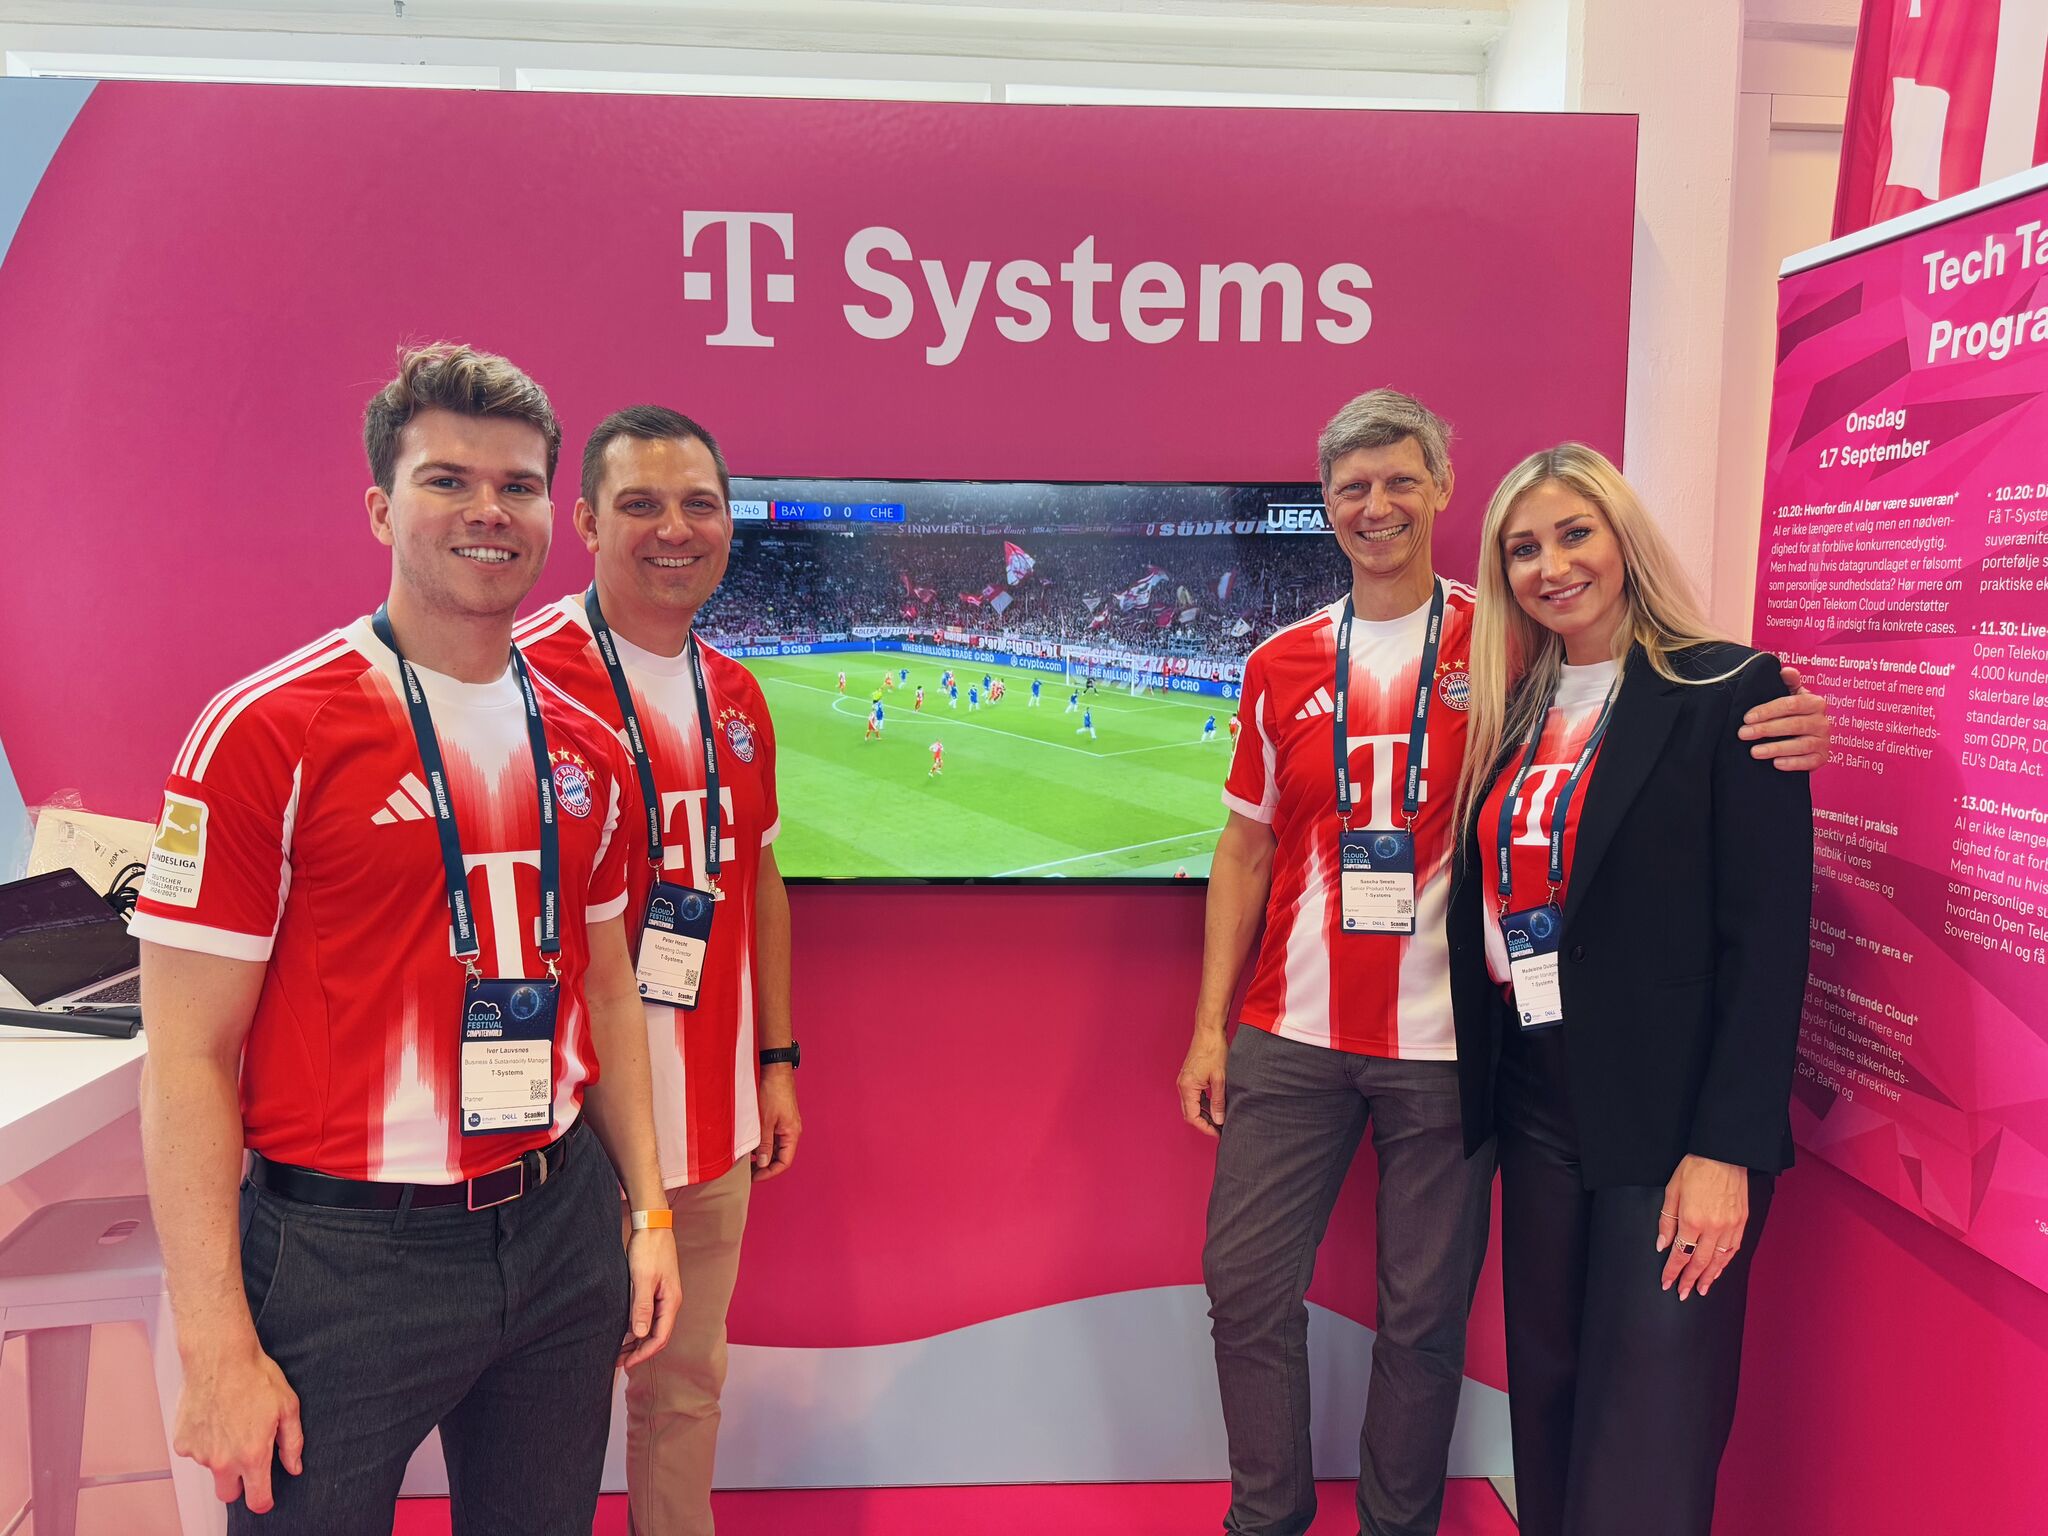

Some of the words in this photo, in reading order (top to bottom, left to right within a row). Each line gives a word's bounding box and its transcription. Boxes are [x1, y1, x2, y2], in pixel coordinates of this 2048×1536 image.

[1923, 236, 2006, 294] Tech
[682, 210, 795, 348] T
[842, 225, 1373, 366] Systems
[1846, 407, 1907, 433] Onsdag
[1819, 448, 1838, 469] 17
[1841, 438, 1930, 468] September
[1995, 485, 2034, 501] 10.20:
[781, 506, 805, 516] BAY
[823, 507, 831, 518] 0
[843, 507, 851, 518] 0
[870, 507, 894, 518] CHE
[1778, 506, 1802, 518] 10.20:
[1804, 503, 1836, 516] Hvorfor
[1838, 502, 1852, 514] din
[1853, 500, 1863, 512] AI
[1865, 499, 1881, 511] bør
[1883, 498, 1907, 510] være
[1988, 508, 2001, 524] Få
[1773, 525, 1781, 536] AI
[1782, 526, 1791, 535] er
[1792, 524, 1807, 535] ikke
[1808, 522, 1842, 534] længere
[1844, 522, 1853, 532] et
[1855, 520, 1874, 533] valg
[1876, 520, 1896, 531] men
[1898, 519, 1911, 529] en
[1912, 515, 1955, 528] nødven-
[1771, 543, 1797, 557] dighed
[1800, 542, 1811, 553] for
[1812, 542, 1820, 553] at
[1822, 539, 1853, 553] forblive
[1855, 537, 1946, 552] konkurrencedygtig.
[1770, 561, 1786, 572] Men
[1788, 560, 1807, 572] hvad
[1809, 562, 1818, 572] nu
[1820, 560, 1837, 571] hvis
[1839, 558, 1908, 574] datagrundlaget
[1910, 559, 1920, 570] er
[1922, 557, 1962, 570] følsomt
[1982, 554, 2039, 572] portefølje
[1769, 582, 1785, 591] som
[1786, 579, 1827, 593] personlige
[1829, 578, 1895, 591] sundhedsdata?
[1898, 579, 1915, 591] Hør
[1917, 579, 1944, 591] mere
[1945, 580, 1962, 591] om
[1980, 577, 2033, 594] praktiske
[1768, 597, 1798, 609] hvordan
[1800, 597, 1821, 612] Open
[1822, 597, 1857, 610] Telekom
[1859, 598, 1885, 611] Cloud
[1888, 600, 1949, 612] understøtter
[1766, 615, 1803, 629] Sovereign
[1804, 616, 1812, 628] AI
[1814, 619, 1825, 630] og
[1827, 615, 1835, 629] få
[1837, 617, 1866, 632] indsigt
[1868, 619, 1880, 631] fra
[1882, 619, 1923, 633] konkrete
[1925, 622, 1957, 634] cases.
[1980, 622, 2018, 636] 11.30:
[745, 646, 778, 656] TRADE
[792, 645, 811, 654] CRO
[951, 649, 973, 660] TRADE
[980, 653, 994, 663] CRO
[1973, 643, 2004, 660] Open
[1019, 658, 1062, 672] crypto.com
[1791, 653, 1838, 668] Live-demo:
[1839, 656, 1878, 672] Europa's
[1880, 658, 1917, 674] førende
[1817, 673, 1840, 687] Cloud
[1843, 676, 1851, 688] er
[1853, 676, 1885, 691] betroet
[1971, 665, 2005, 681] 4.000
[1181, 680, 1200, 691] CRO
[1441, 678, 1449, 688] FC
[1968, 688, 2029, 705] skalerbare
[1966, 710, 2030, 728] standarder
[1964, 733, 1988, 745] som
[1991, 734, 2029, 754] GDPR,
[1962, 751, 1986, 768] EU's
[1989, 755, 2017, 773] Data
[2019, 760, 2044, 777] Act.
[556, 774, 562, 786] FC
[1345, 732, 1430, 831] T
[431, 770, 451, 820] COMPUTERWORLD
[541, 777, 553, 824] COMPUTERWORLD
[1512, 762, 1577, 846] T
[1961, 795, 1998, 814] 13.00:
[1865, 818, 1898, 836] praksis
[1954, 816, 1966, 830] AI
[1969, 822, 1980, 833] er
[1983, 821, 2005, 838] ikke
[1952, 839, 1991, 858] dighed
[1994, 848, 2010, 862] for
[2013, 853, 2024, 866] at
[453, 890, 470, 939] COMPUTERWORLD
[546, 890, 554, 939] COMPUTERWORLD
[467, 1021, 502, 1029] FESTIVAL
